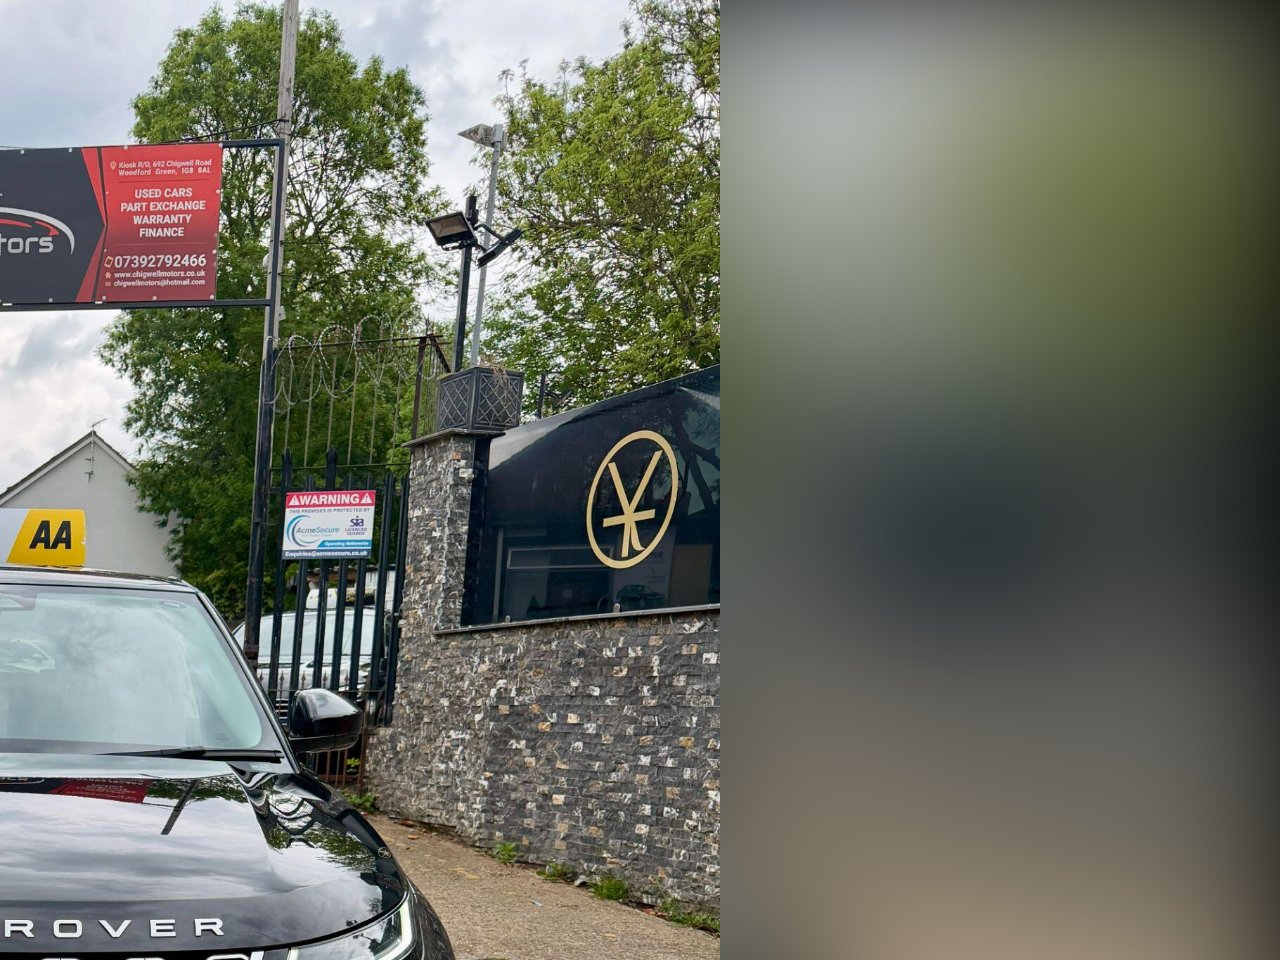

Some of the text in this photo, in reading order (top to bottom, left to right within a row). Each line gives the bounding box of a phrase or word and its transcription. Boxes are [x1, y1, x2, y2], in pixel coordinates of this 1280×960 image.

[153, 160, 165, 168] 692
[166, 159, 194, 168] Chigwell
[195, 158, 212, 166] Road
[119, 168, 151, 176] Woodford
[135, 187, 193, 199] USED CARS
[121, 200, 206, 212] PART EXCHANGE
[133, 214, 192, 225] WARRANTY
[139, 227, 185, 238] FINANCE
[114, 254, 207, 268] 07392792466
[300, 494, 360, 505] WARNING
[28, 520, 72, 550] AA
[4, 917, 225, 939] ROVER
